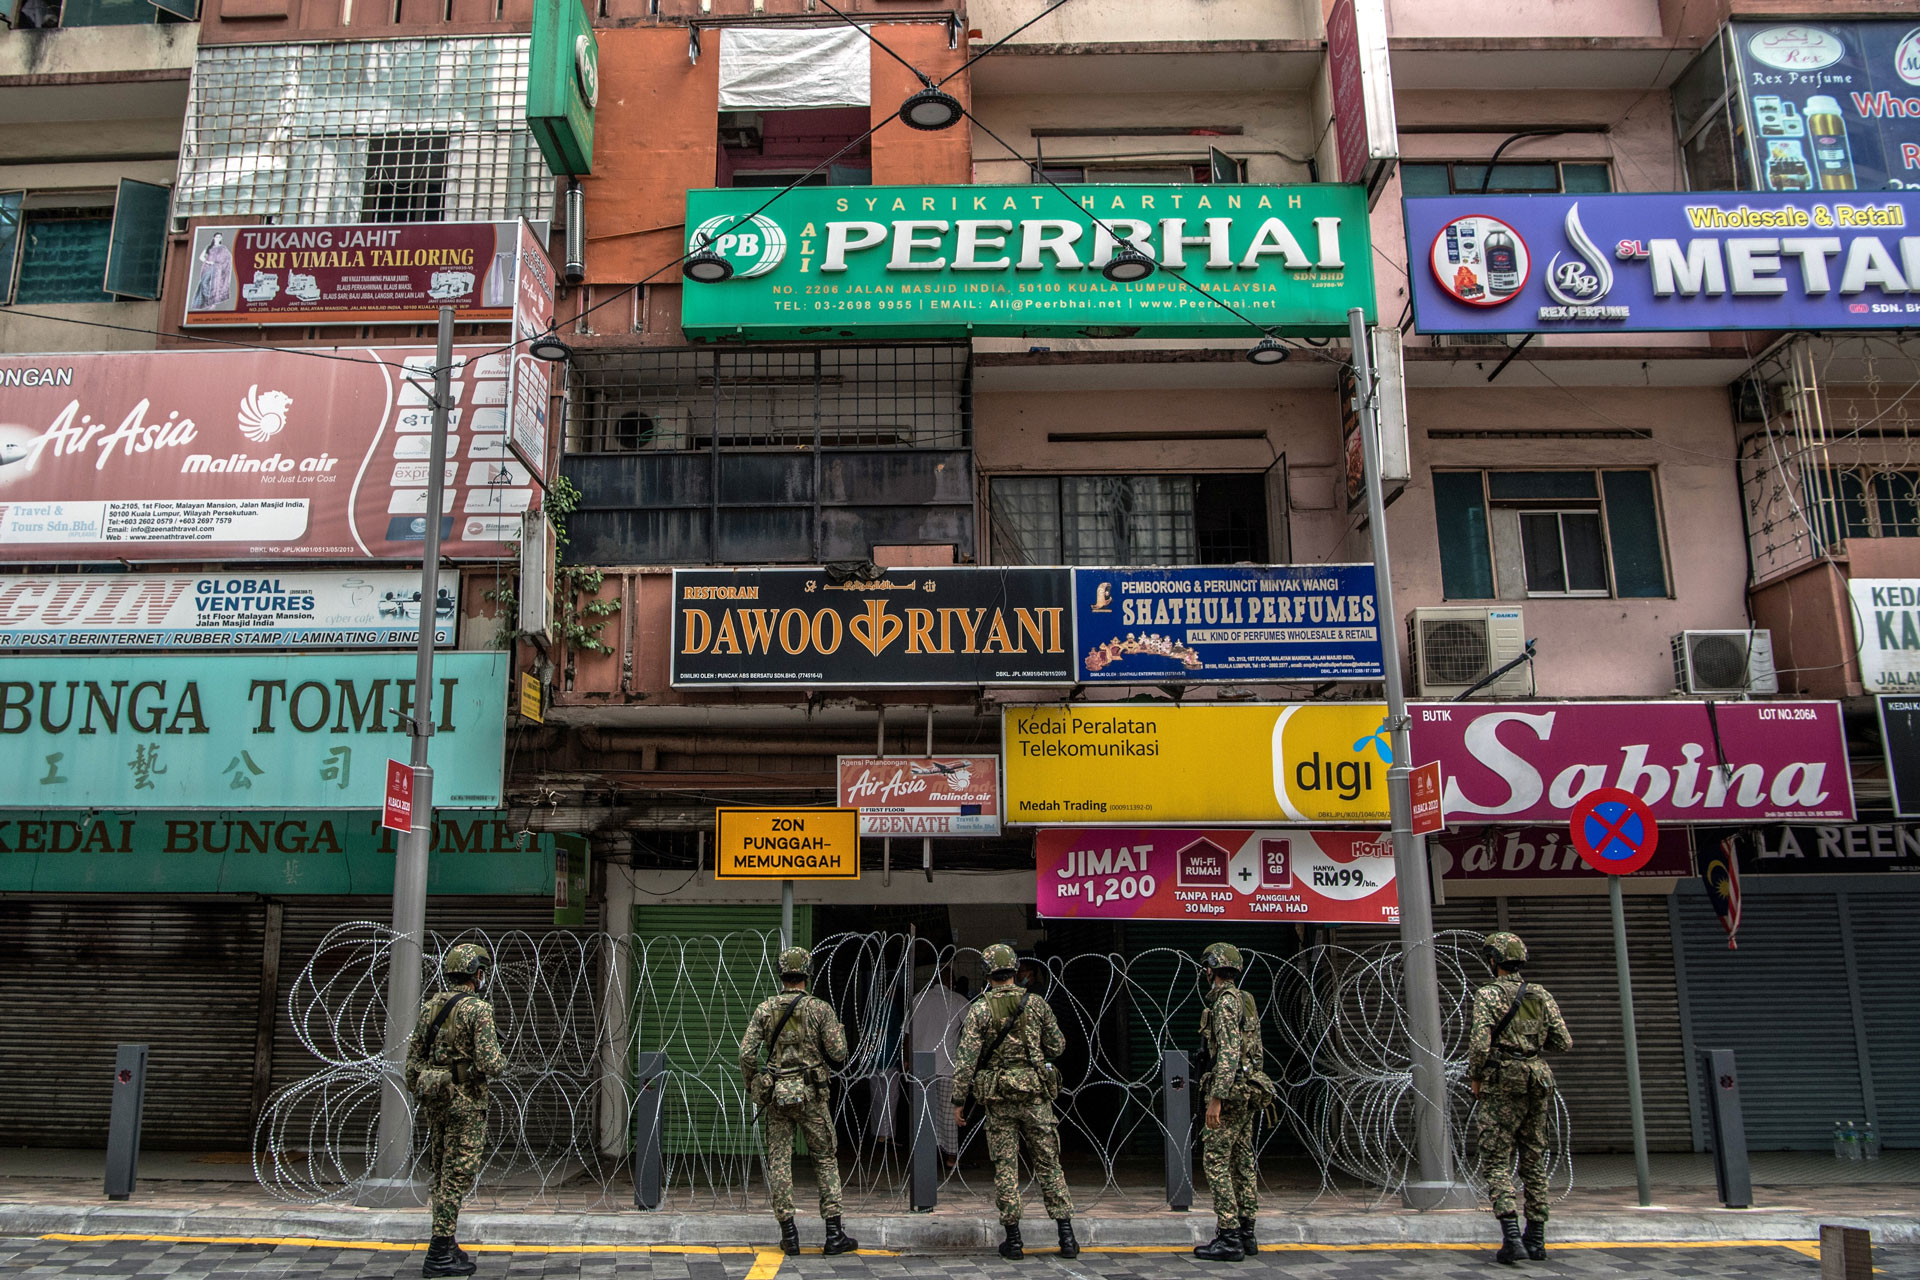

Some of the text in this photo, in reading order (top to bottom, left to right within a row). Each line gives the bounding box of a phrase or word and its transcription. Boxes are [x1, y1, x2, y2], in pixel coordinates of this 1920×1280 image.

[1785, 50, 1824, 64] Rex
[1752, 72, 1852, 88] Rex Perfume
[836, 194, 1302, 212] SYARIKAT HARTANAH
[1688, 206, 1904, 228] Wholesale & Retail
[243, 230, 401, 250] TUKANG JAHIT
[715, 233, 760, 256] PB
[820, 216, 1346, 272] PEERBHAI
[1617, 240, 1650, 259] SL
[254, 248, 474, 270] SRI VIMALA TAILORING
[1648, 236, 1920, 296] META
[1293, 272, 1344, 281] SDN BHD
[772, 283, 1278, 294] NO. 2206 JALAN MASJID INDIA, 50100 KUALA LUMPUR, MALAYSIA
[774, 298, 1277, 311] TEL: 03-2698 9955 EMAIL: Ali@Peerbhai.net www.Peerbhai.net
[1872, 304, 1903, 312] SDN.
[1538, 305, 1630, 320] REX PERFUME
[0, 367, 73, 387] NGAN
[25, 398, 198, 471] Air Asia
[180, 452, 338, 473] Malindo air
[261, 474, 336, 483] Not Just Low Cost
[14, 506, 63, 516] Travel &
[176, 502, 205, 510] Malayan
[12, 522, 43, 532] Tours
[196, 579, 286, 594] GLOBAL
[683, 586, 759, 600] RESTORAN
[1121, 578, 1338, 594] PEMBORONG & PERUNCIT MINYAK WANGI
[194, 596, 315, 611] VENTURES
[1122, 595, 1376, 626] SHATHULI PERFUMES
[238, 613, 273, 621] Malayan
[276, 612, 315, 620] Mansion,
[325, 614, 351, 624] cyber
[222, 620, 250, 628] Masjid
[904, 606, 1065, 654] RIYANI
[21, 632, 378, 645] PUSAT BERINTERNET RUBBER STAMP LAMINATING
[1192, 630, 1372, 641] ALL KIND OF PERFUMES WHOLESALE & RETAIL
[0, 680, 210, 734] BUNGA
[1423, 710, 1452, 722] BUTIK
[1758, 709, 1817, 720] LOT NO.206A
[1018, 718, 1156, 734] Kedai Peralatan
[1020, 740, 1159, 756] Telekomunikasi
[1442, 710, 1829, 816] Sabina
[1296, 752, 1371, 800] digi
[848, 769, 927, 804] Air Asia
[1019, 800, 1107, 813] Medah Trading
[772, 819, 805, 832] ZON
[867, 817, 950, 832] ZEENATH
[163, 820, 343, 853] BUNGA
[744, 837, 832, 850] PUNGGAH-
[1756, 826, 1804, 859] LA
[734, 855, 841, 868] MEMUNGGAH
[1057, 844, 1153, 878] JIMAT
[1190, 857, 1216, 866] Wi-Fi
[1267, 853, 1284, 864] 20
[1186, 868, 1221, 876] RUMAH
[1269, 866, 1283, 874] GB
[1174, 891, 1233, 901] TANPA HAD
[1256, 894, 1300, 902] PANGGILAN
[1185, 904, 1225, 915] 30 Mbps
[1249, 903, 1308, 913] TANPA HAD
